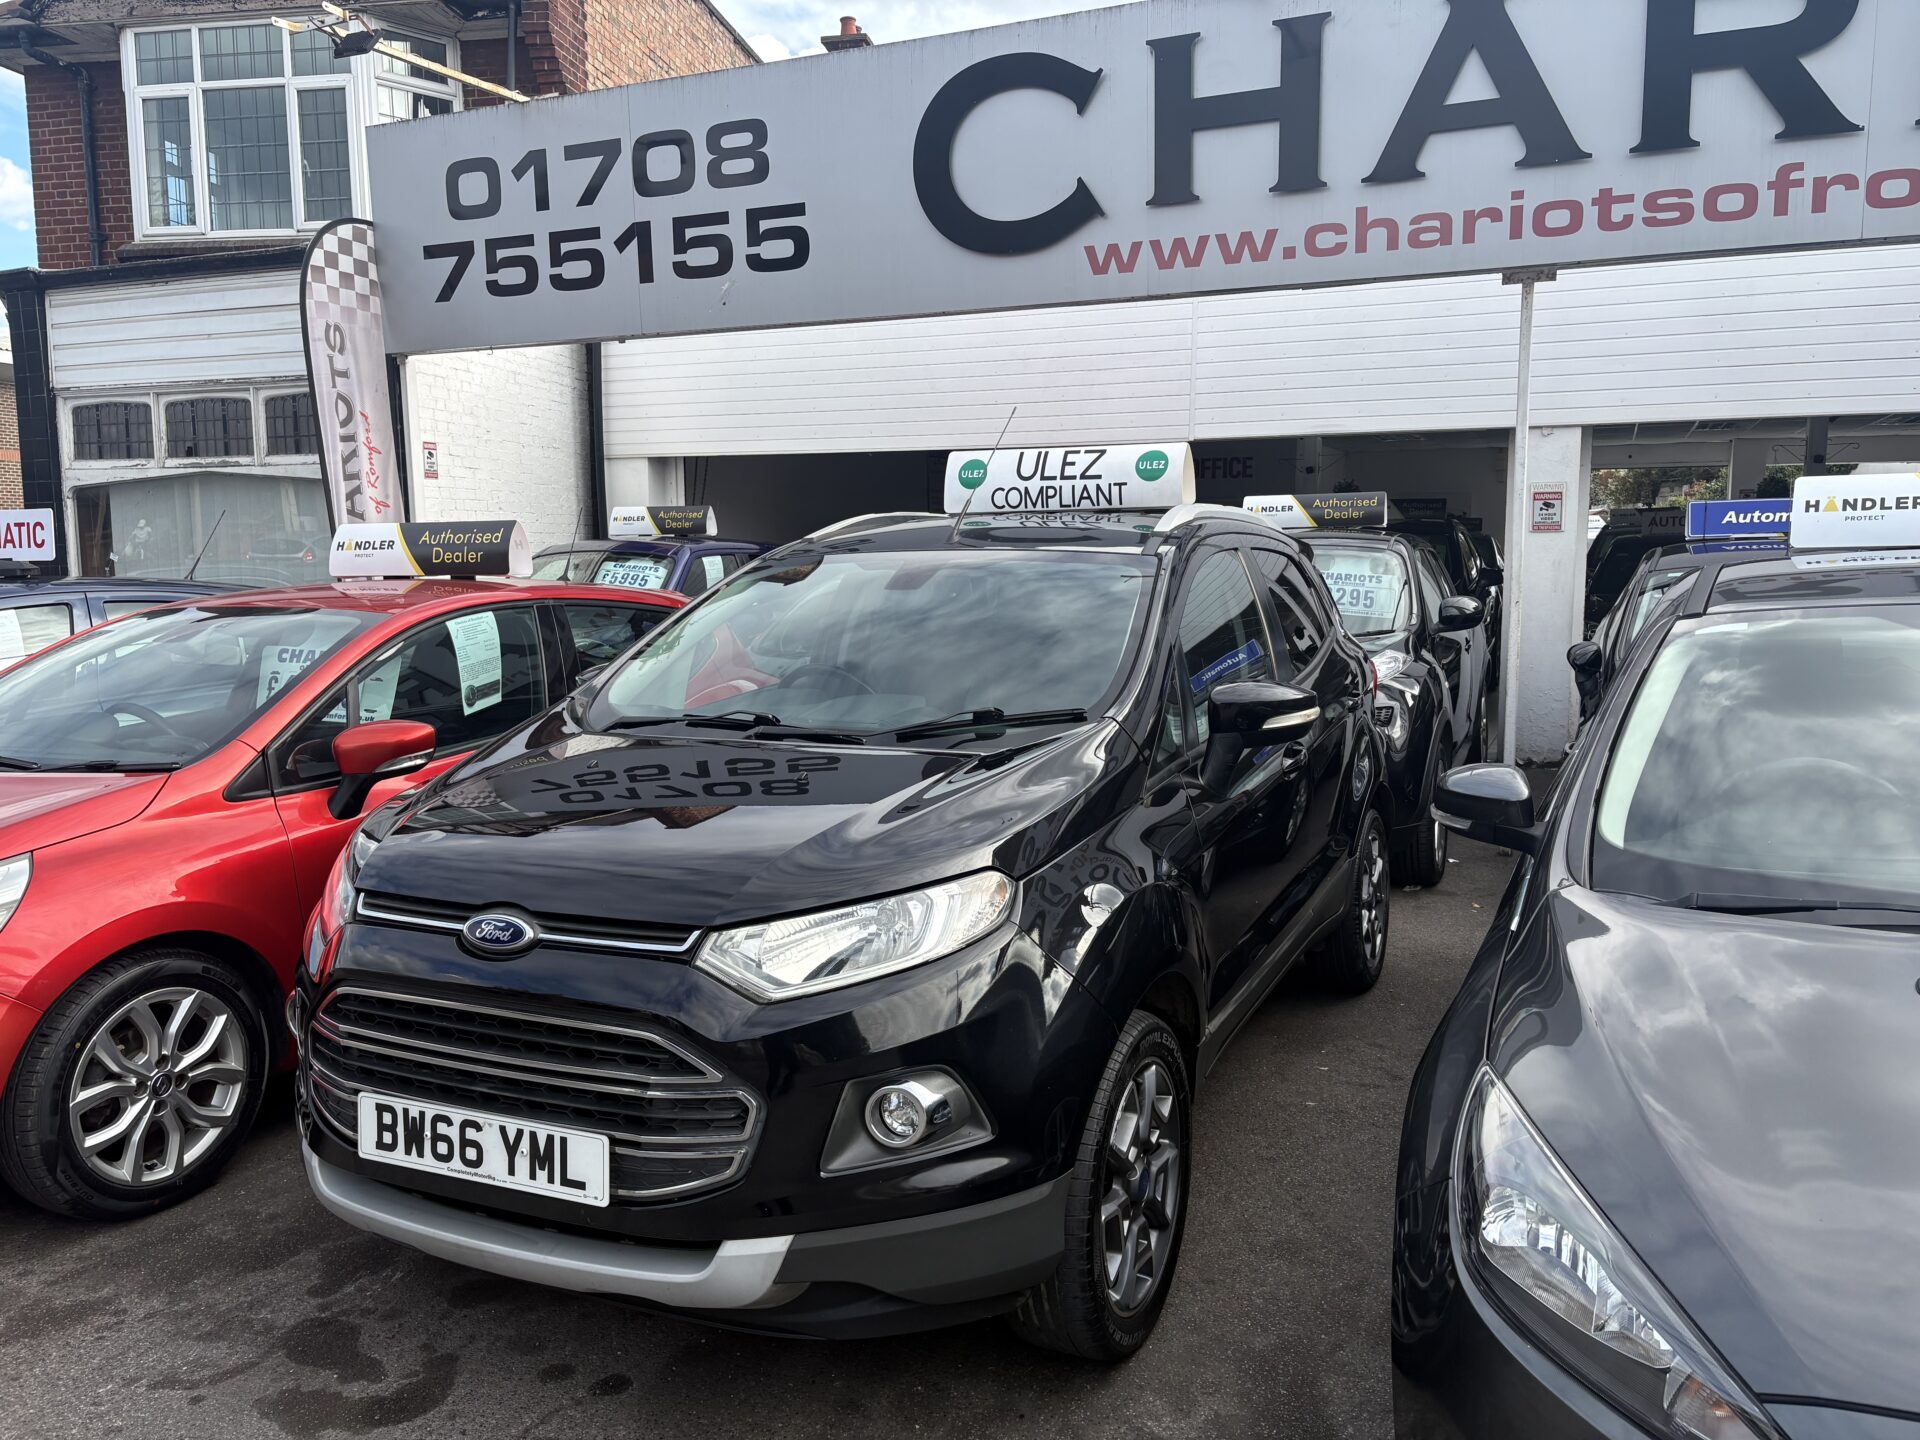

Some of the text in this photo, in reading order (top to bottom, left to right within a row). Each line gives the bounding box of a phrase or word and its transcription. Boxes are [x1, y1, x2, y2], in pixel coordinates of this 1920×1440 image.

[913, 0, 1920, 257] CHAR
[445, 118, 770, 221] 01708
[422, 202, 811, 303] 755155
[1016, 448, 1107, 482] ULEZ
[1138, 460, 1166, 470] ULEZ
[961, 469, 985, 479] ULEZ
[990, 481, 1128, 510] COMPLIANT
[1312, 496, 1378, 508] Authorised
[658, 510, 704, 519] Authorised
[1324, 508, 1364, 520] Dealer
[1844, 514, 1886, 522] PROTECT
[665, 520, 694, 529] Dealer
[0, 521, 46, 549] ATIC
[418, 527, 504, 545] Authorised
[432, 547, 484, 563] Dealer
[613, 563, 661, 573] CHARIOTS
[276, 647, 324, 663] CHA
[475, 920, 514, 941] Ford
[375, 1102, 587, 1191] BW66 YML
